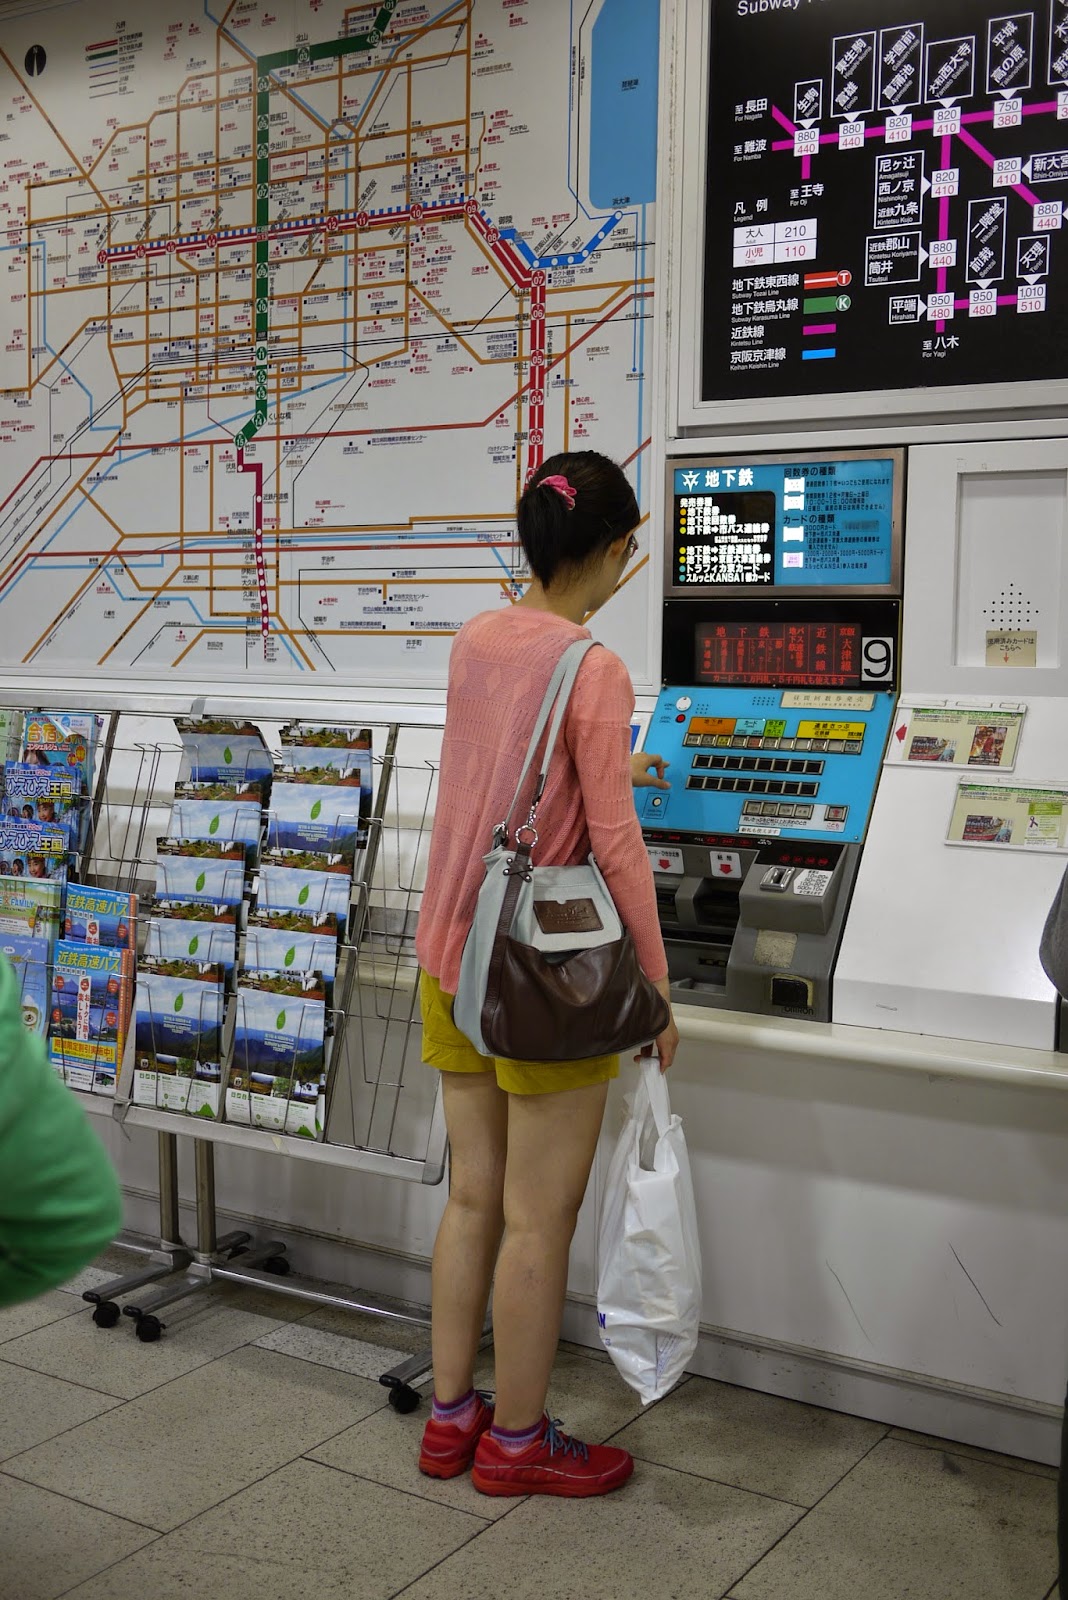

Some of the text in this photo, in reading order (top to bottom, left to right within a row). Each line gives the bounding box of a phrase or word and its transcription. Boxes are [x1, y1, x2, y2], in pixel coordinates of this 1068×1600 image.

[737, 0, 800, 16] Subway
[992, 21, 1018, 47] 平城
[883, 30, 916, 65] 学園前
[835, 38, 867, 74] 東生駒
[929, 43, 971, 94] 大和西大寺
[990, 45, 1025, 83] 高の原
[835, 81, 858, 107] 富雄
[797, 87, 819, 114] 生駒
[1000, 101, 1018, 112] 750
[937, 109, 957, 120] 820
[998, 115, 1017, 126] 380
[889, 116, 909, 127] 820
[842, 124, 861, 134] 880
[888, 130, 908, 140] 410
[937, 124, 957, 134] 410
[797, 131, 816, 141] 880
[842, 137, 860, 147] 440
[797, 144, 815, 153] 440
[997, 160, 1018, 171] 820
[936, 171, 955, 182] 820
[997, 174, 1017, 184] 410
[879, 179, 915, 195] 西ノ京
[935, 185, 955, 195] 410
[878, 202, 919, 218] 近鉄九条
[1037, 204, 1058, 216] 880
[971, 202, 1005, 239] 二階堂
[1037, 218, 1058, 229] 440
[746, 225, 806, 239] 大人 210
[869, 236, 910, 253] 近鉄郡山
[933, 242, 953, 253] 880
[745, 245, 806, 259] 小児 110
[1019, 241, 1046, 268] 天理
[933, 255, 952, 266] 440
[868, 260, 893, 276] 筒井
[732, 273, 799, 292] 地下鉄東西線
[972, 290, 993, 301] 950
[1019, 286, 1044, 298] 1,010
[931, 294, 951, 306] 950
[1020, 300, 1042, 311] 510
[892, 299, 917, 314] 平端
[972, 304, 993, 314] 480
[931, 308, 950, 319] 480
[731, 325, 765, 339] 近鉄線
[730, 347, 787, 364] 京阪京津線
[704, 468, 754, 488] 地下鉄
[784, 466, 836, 478] 回数券の種類
[783, 513, 835, 525] カードの種類
[863, 638, 891, 678] 9
[6, 777, 72, 798] ひえひえ王国
[66, 894, 129, 917] 近鉄高速バス
[57, 951, 121, 972] 近鉄高速バス
